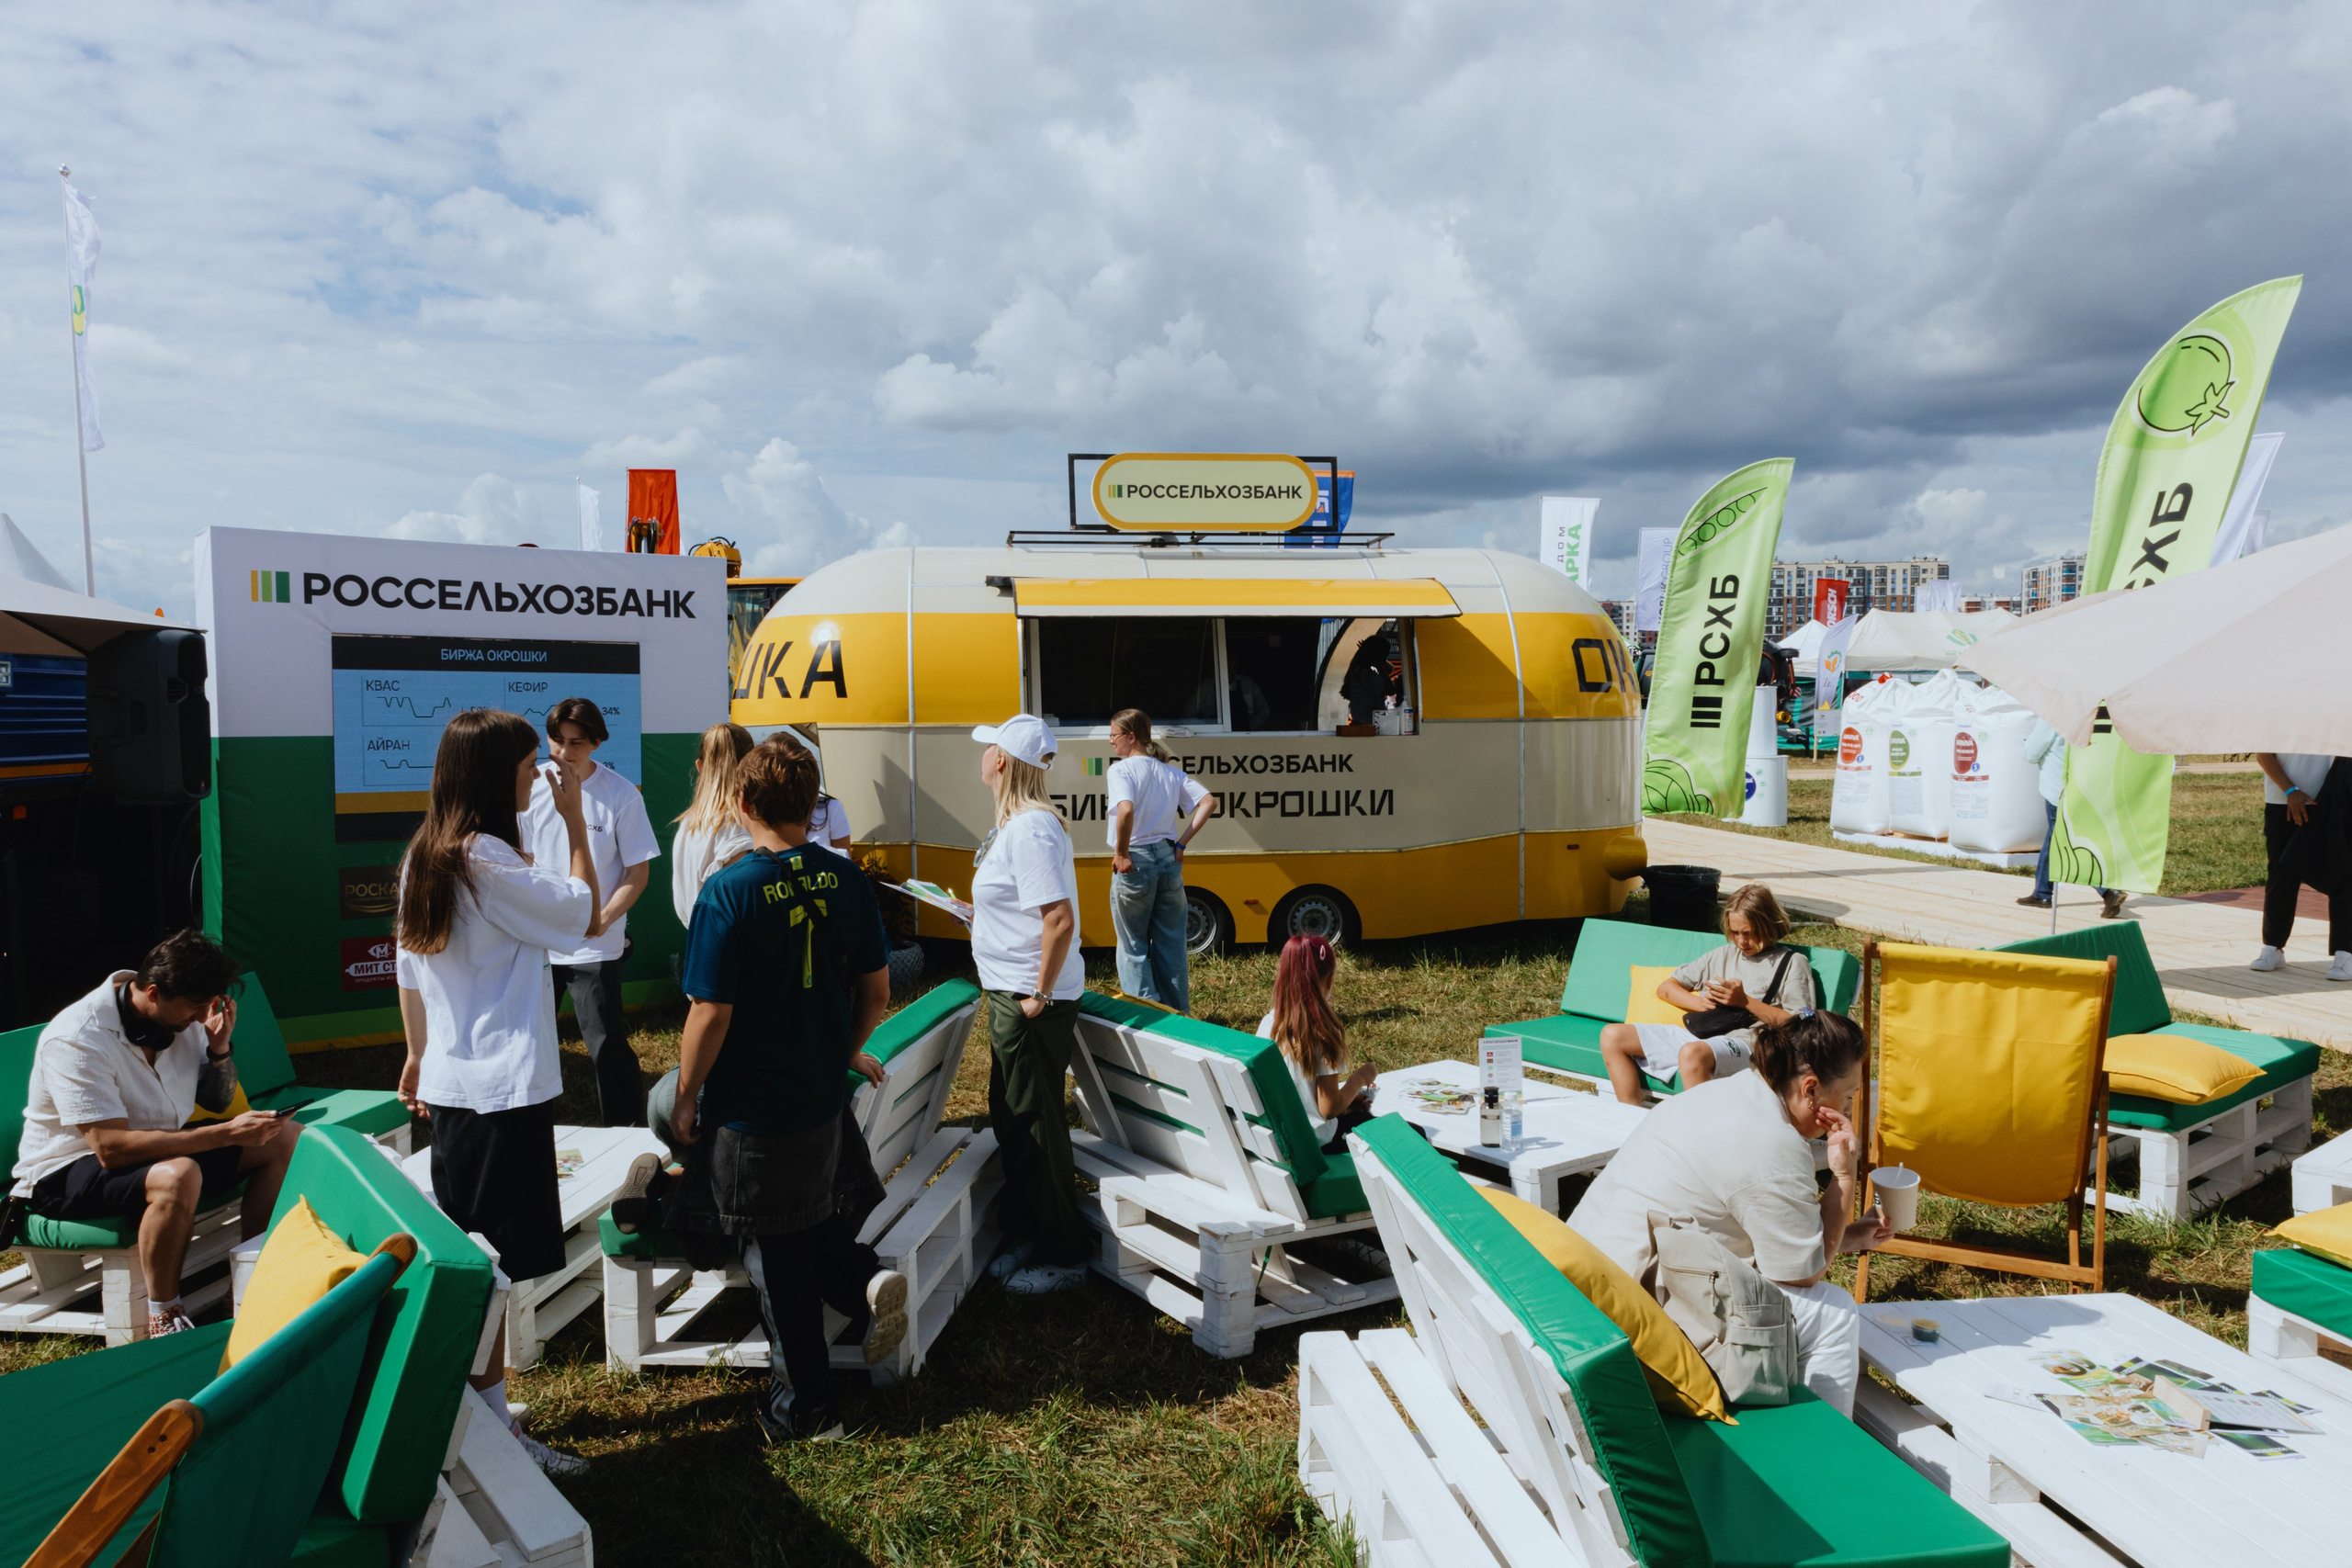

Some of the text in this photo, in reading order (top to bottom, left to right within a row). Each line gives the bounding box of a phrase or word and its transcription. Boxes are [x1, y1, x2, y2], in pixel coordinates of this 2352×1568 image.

[1127, 483, 1303, 500] РОССЕЛЬХОЗБАНК
[1557, 526, 1566, 563] ДОМ
[2123, 482, 2194, 590] ХБ
[303, 572, 697, 619] РОССЕЛЬХОЗБАНК
[1694, 573, 1740, 686] РСХБ
[441, 649, 548, 662] БИРЖА ОКРОШКИ
[366, 680, 401, 692] КВАС
[508, 682, 548, 693] КЕФИР
[368, 737, 411, 751] АЙРАН
[1109, 754, 1354, 774] ЕЛЬХОЗБАНК
[354, 962, 380, 975] МИТ
